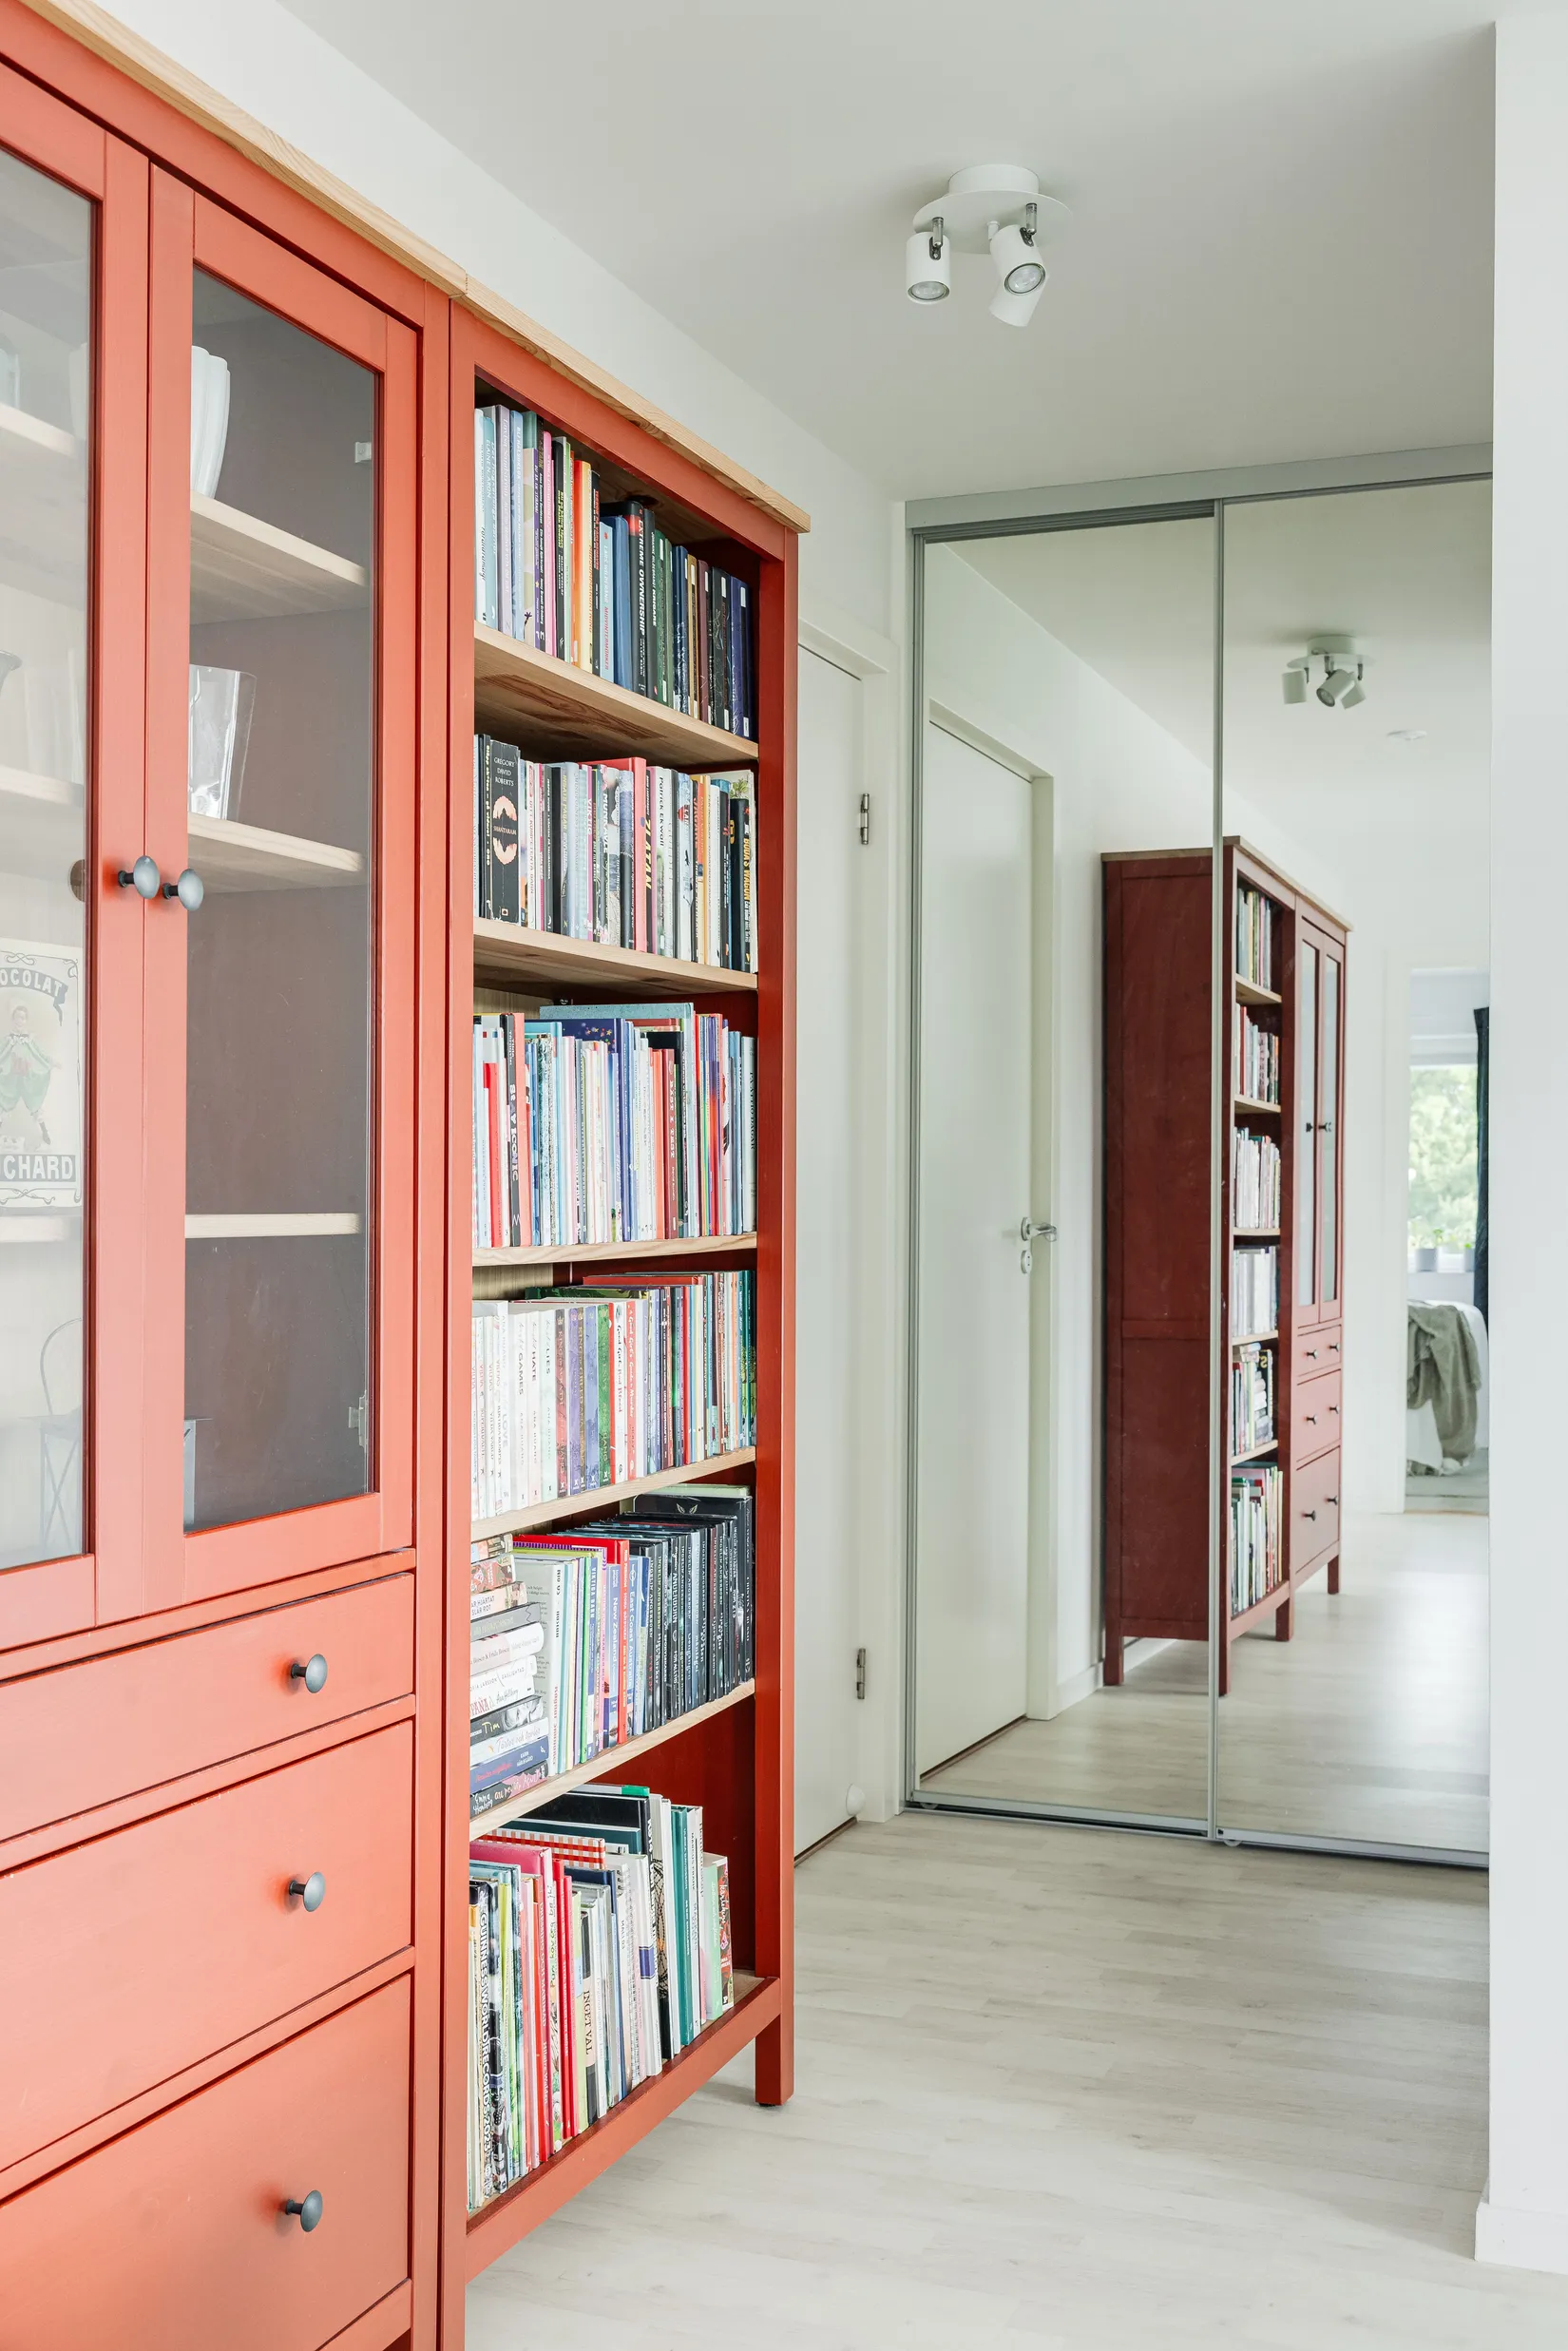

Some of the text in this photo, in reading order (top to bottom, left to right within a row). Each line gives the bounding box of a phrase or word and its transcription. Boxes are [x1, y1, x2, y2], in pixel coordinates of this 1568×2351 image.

[494, 756, 515, 767] GREGORY
[497, 767, 511, 776] DAVID
[495, 776, 514, 787] ROBERTS
[493, 825, 517, 835] SHANTARAM
[0, 968, 62, 997] OCOLAT
[3, 1156, 73, 1180] CHARD
[478, 1596, 495, 1606] HJÄRTAT
[482, 1721, 500, 1734] Tim
[480, 1913, 488, 1987] GUINNESS
[481, 1988, 490, 2043] WORLD
